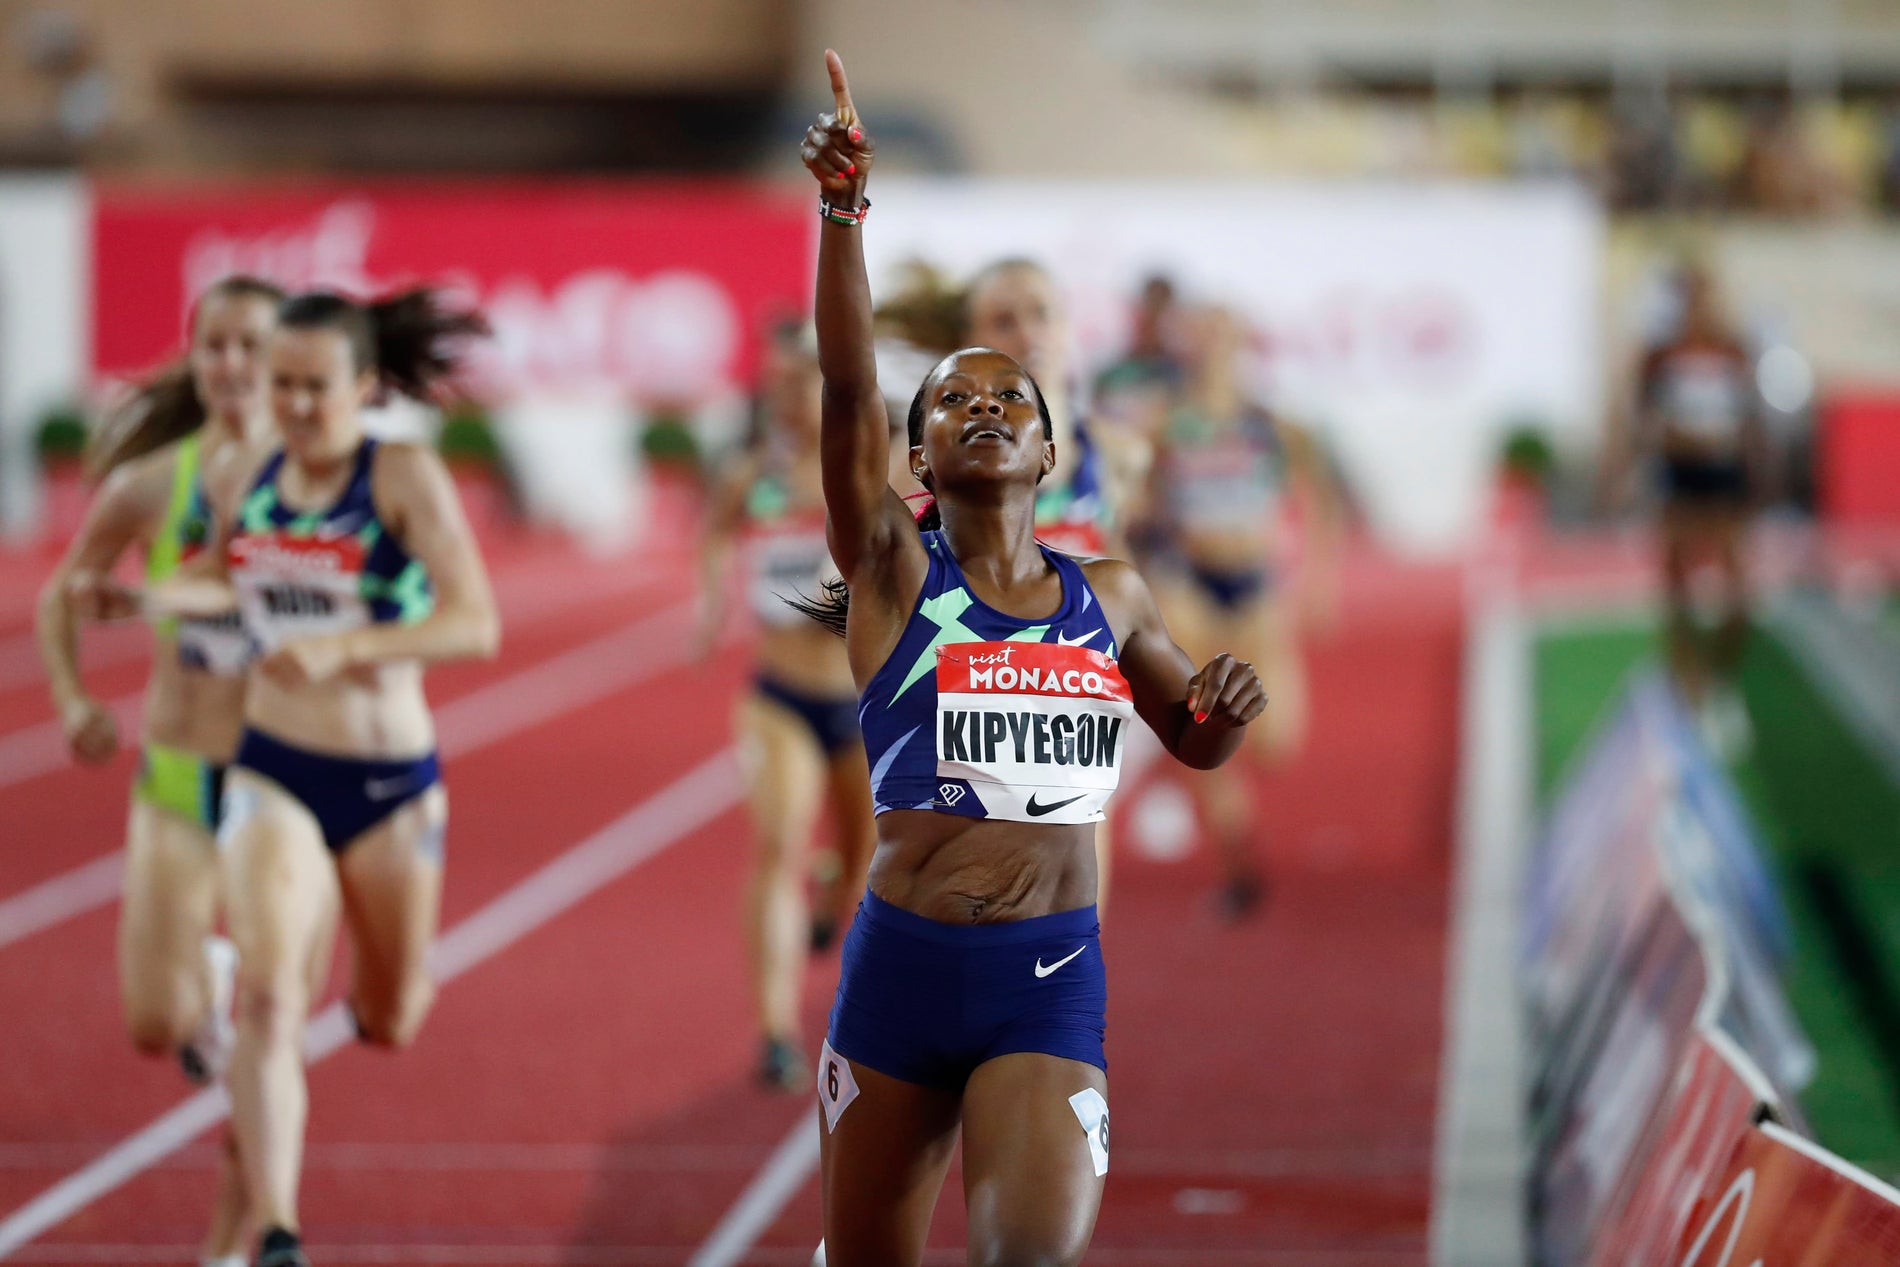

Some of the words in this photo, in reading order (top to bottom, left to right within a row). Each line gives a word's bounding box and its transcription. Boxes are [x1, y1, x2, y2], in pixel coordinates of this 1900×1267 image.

[968, 646, 1016, 665] visit
[969, 666, 1102, 694] MONACO
[943, 710, 1121, 767] KIPYEGON
[828, 1060, 839, 1102] 6
